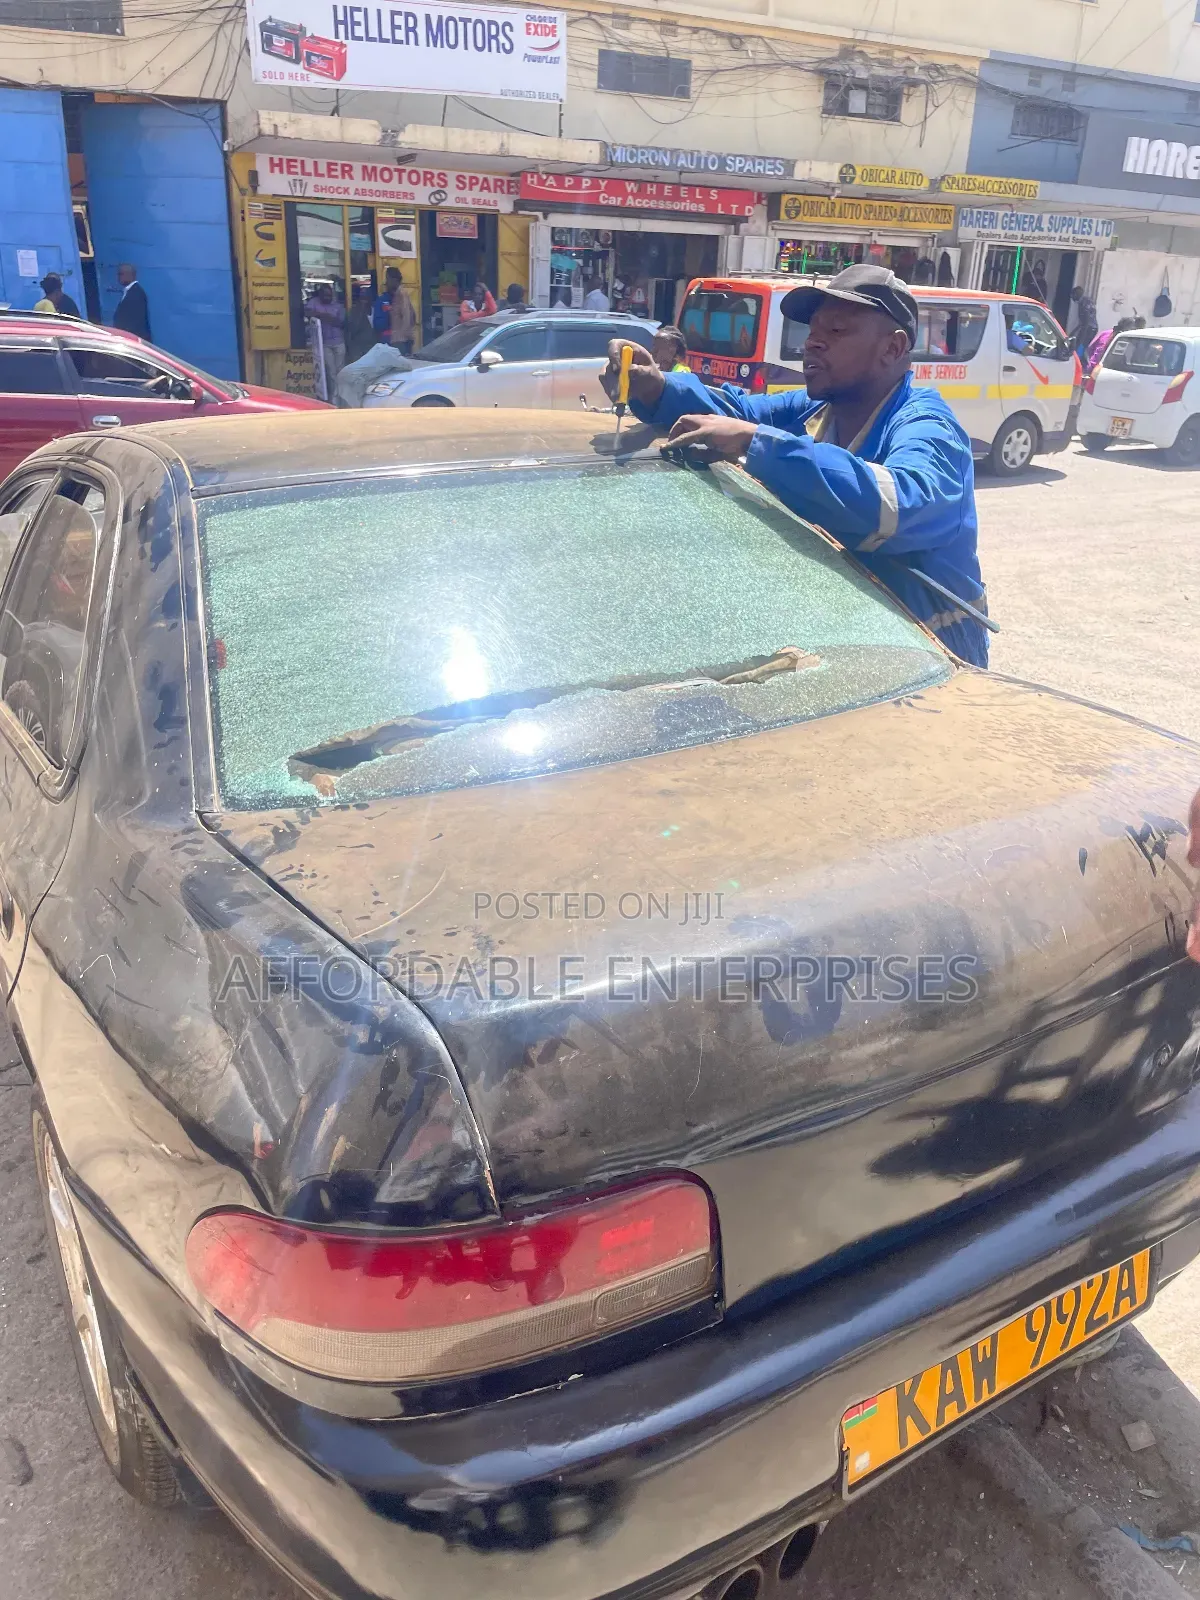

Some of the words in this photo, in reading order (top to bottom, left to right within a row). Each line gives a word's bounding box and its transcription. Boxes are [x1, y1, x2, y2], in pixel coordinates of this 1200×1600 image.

[526, 14, 557, 24] CHLORIDE
[333, 4, 420, 46] HELLER
[425, 14, 515, 54] MOTORS
[525, 22, 557, 38] EXIDE
[262, 70, 285, 80] SOLD
[288, 72, 311, 82] HERE
[606, 146, 670, 167] MICRON
[677, 152, 719, 171] AUTO
[725, 156, 785, 176] SPARES
[1122, 136, 1200, 180] HARE
[268, 156, 355, 182] HELLER
[361, 165, 448, 189] MOTORS
[861, 168, 897, 185] OBICAR
[899, 170, 924, 187] AUTO
[313, 183, 350, 196] SHOCK
[354, 187, 415, 201] ABSORBERS
[527, 173, 608, 192] HAPPY
[625, 180, 719, 201] WHEELS
[944, 175, 978, 192] SPARES
[455, 196, 469, 205] OIL
[471, 197, 498, 207] SEALS
[598, 192, 622, 206] Car
[625, 195, 706, 213] Accessories
[717, 204, 754, 217] LTD
[803, 199, 836, 218] OBICAR
[838, 202, 862, 220] AUTO
[960, 211, 999, 230] HARERI
[1001, 212, 1044, 233] GENERAL
[1047, 215, 1093, 236] SUPPLIES
[1095, 219, 1113, 238] LTD
[1058, 235, 1070, 243] And
[1071, 236, 1092, 245] Spares
[915, 364, 933, 380] LINE
[934, 364, 968, 380] SERVICES
[896, 1331, 1000, 1450] KAW
[1025, 1256, 1138, 1370] 992A
